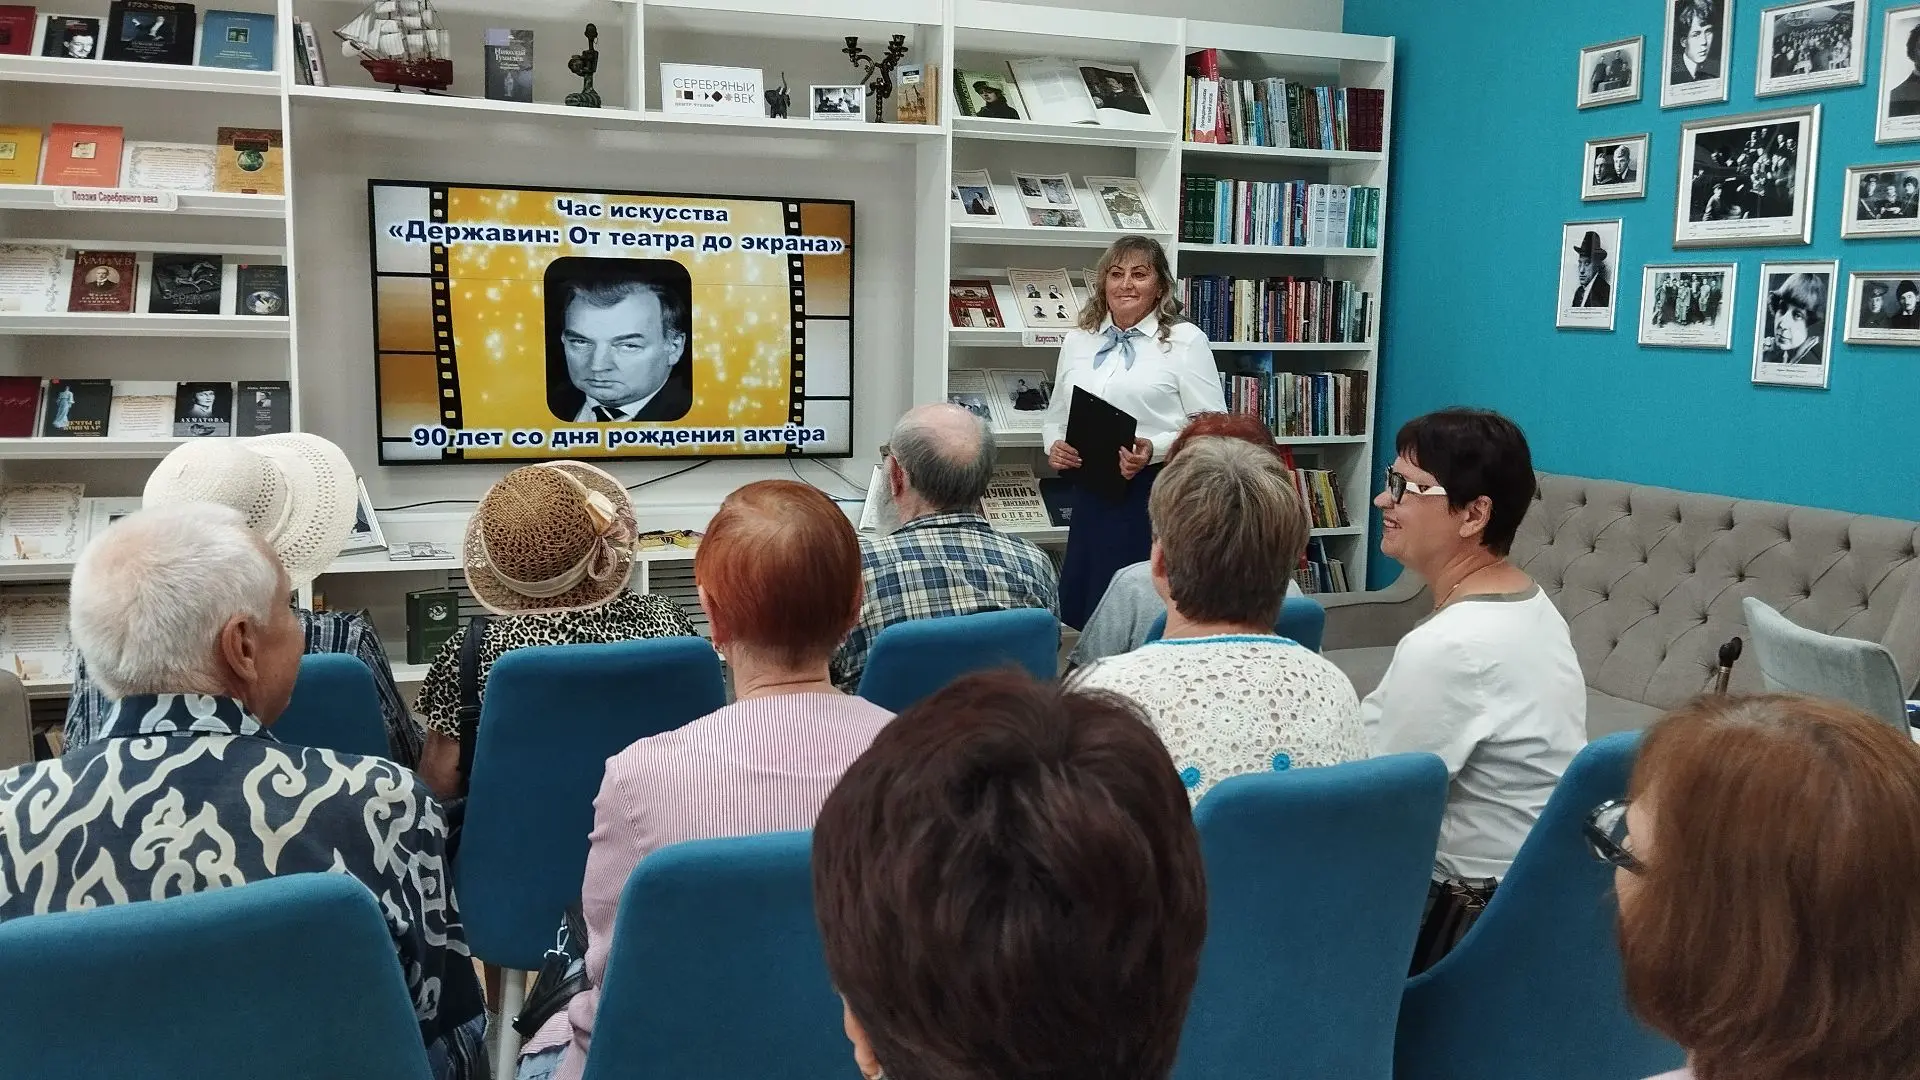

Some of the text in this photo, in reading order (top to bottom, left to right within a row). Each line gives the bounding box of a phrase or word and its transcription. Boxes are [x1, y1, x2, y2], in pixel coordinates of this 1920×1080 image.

[734, 93, 756, 104] ВЕК
[556, 198, 729, 223] Час искусства
[388, 219, 844, 255] «Державин: От театра до экрана»
[413, 425, 825, 448] 90 лет со дня рождения актёра
